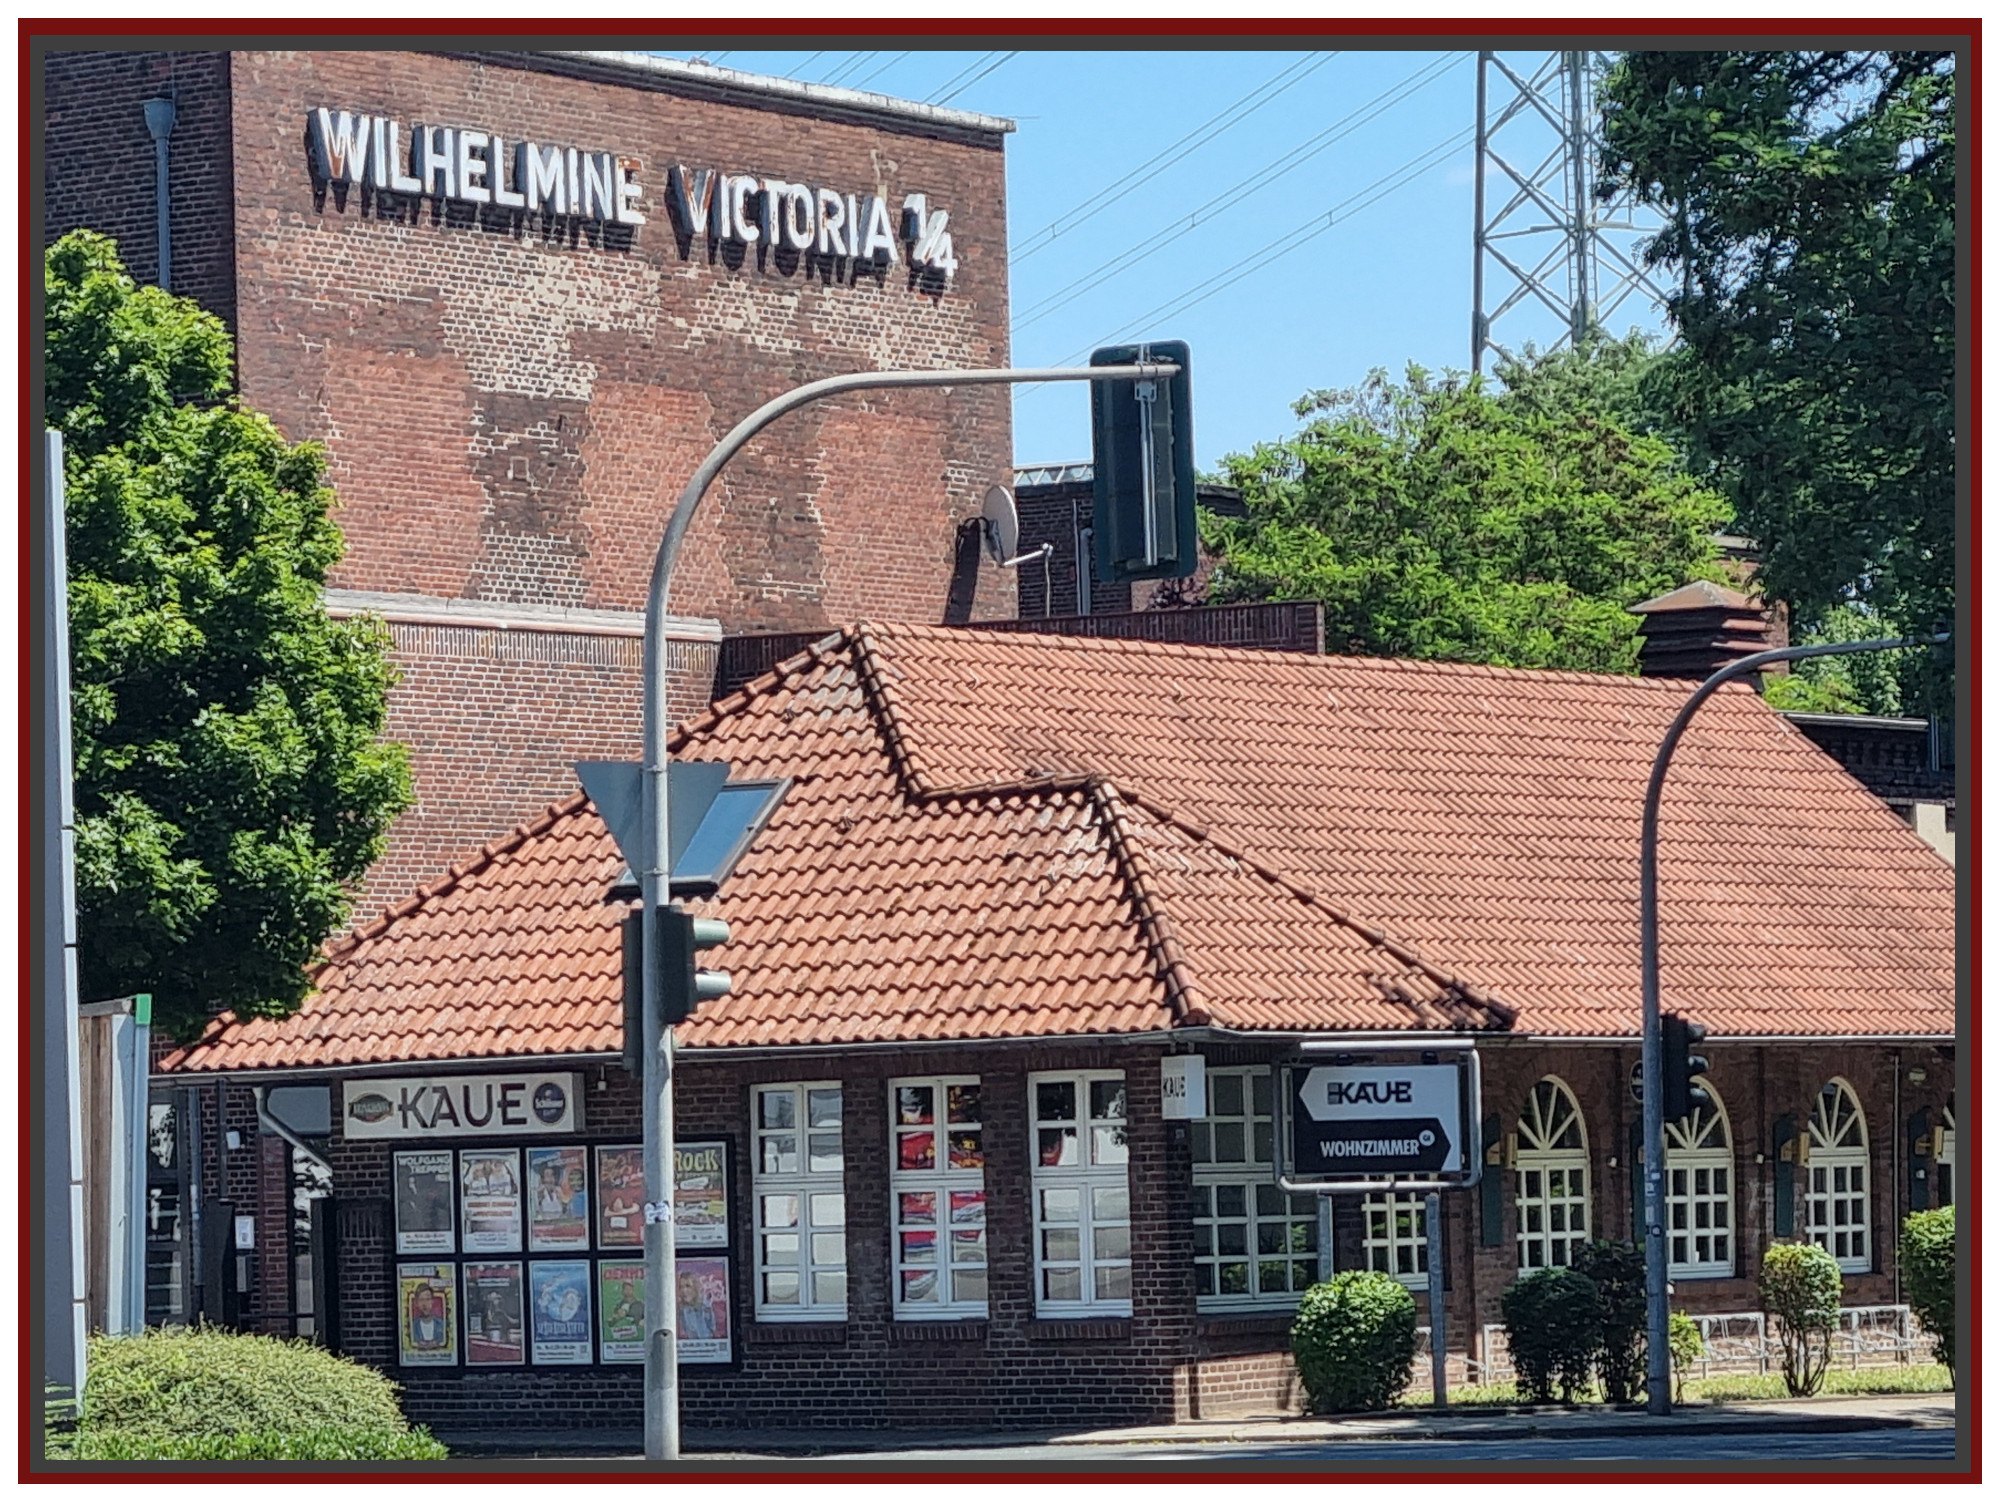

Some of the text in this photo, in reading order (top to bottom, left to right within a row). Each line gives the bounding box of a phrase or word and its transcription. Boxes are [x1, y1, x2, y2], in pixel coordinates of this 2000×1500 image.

[307, 107, 647, 226] WILHELMINE
[667, 163, 899, 262] VICTORIA
[1163, 1076, 1185, 1098] KAUE
[1328, 1081, 1412, 1105] KAUE
[398, 1082, 528, 1129] KAUE
[1320, 1139, 1420, 1157] WOHNZIMMER
